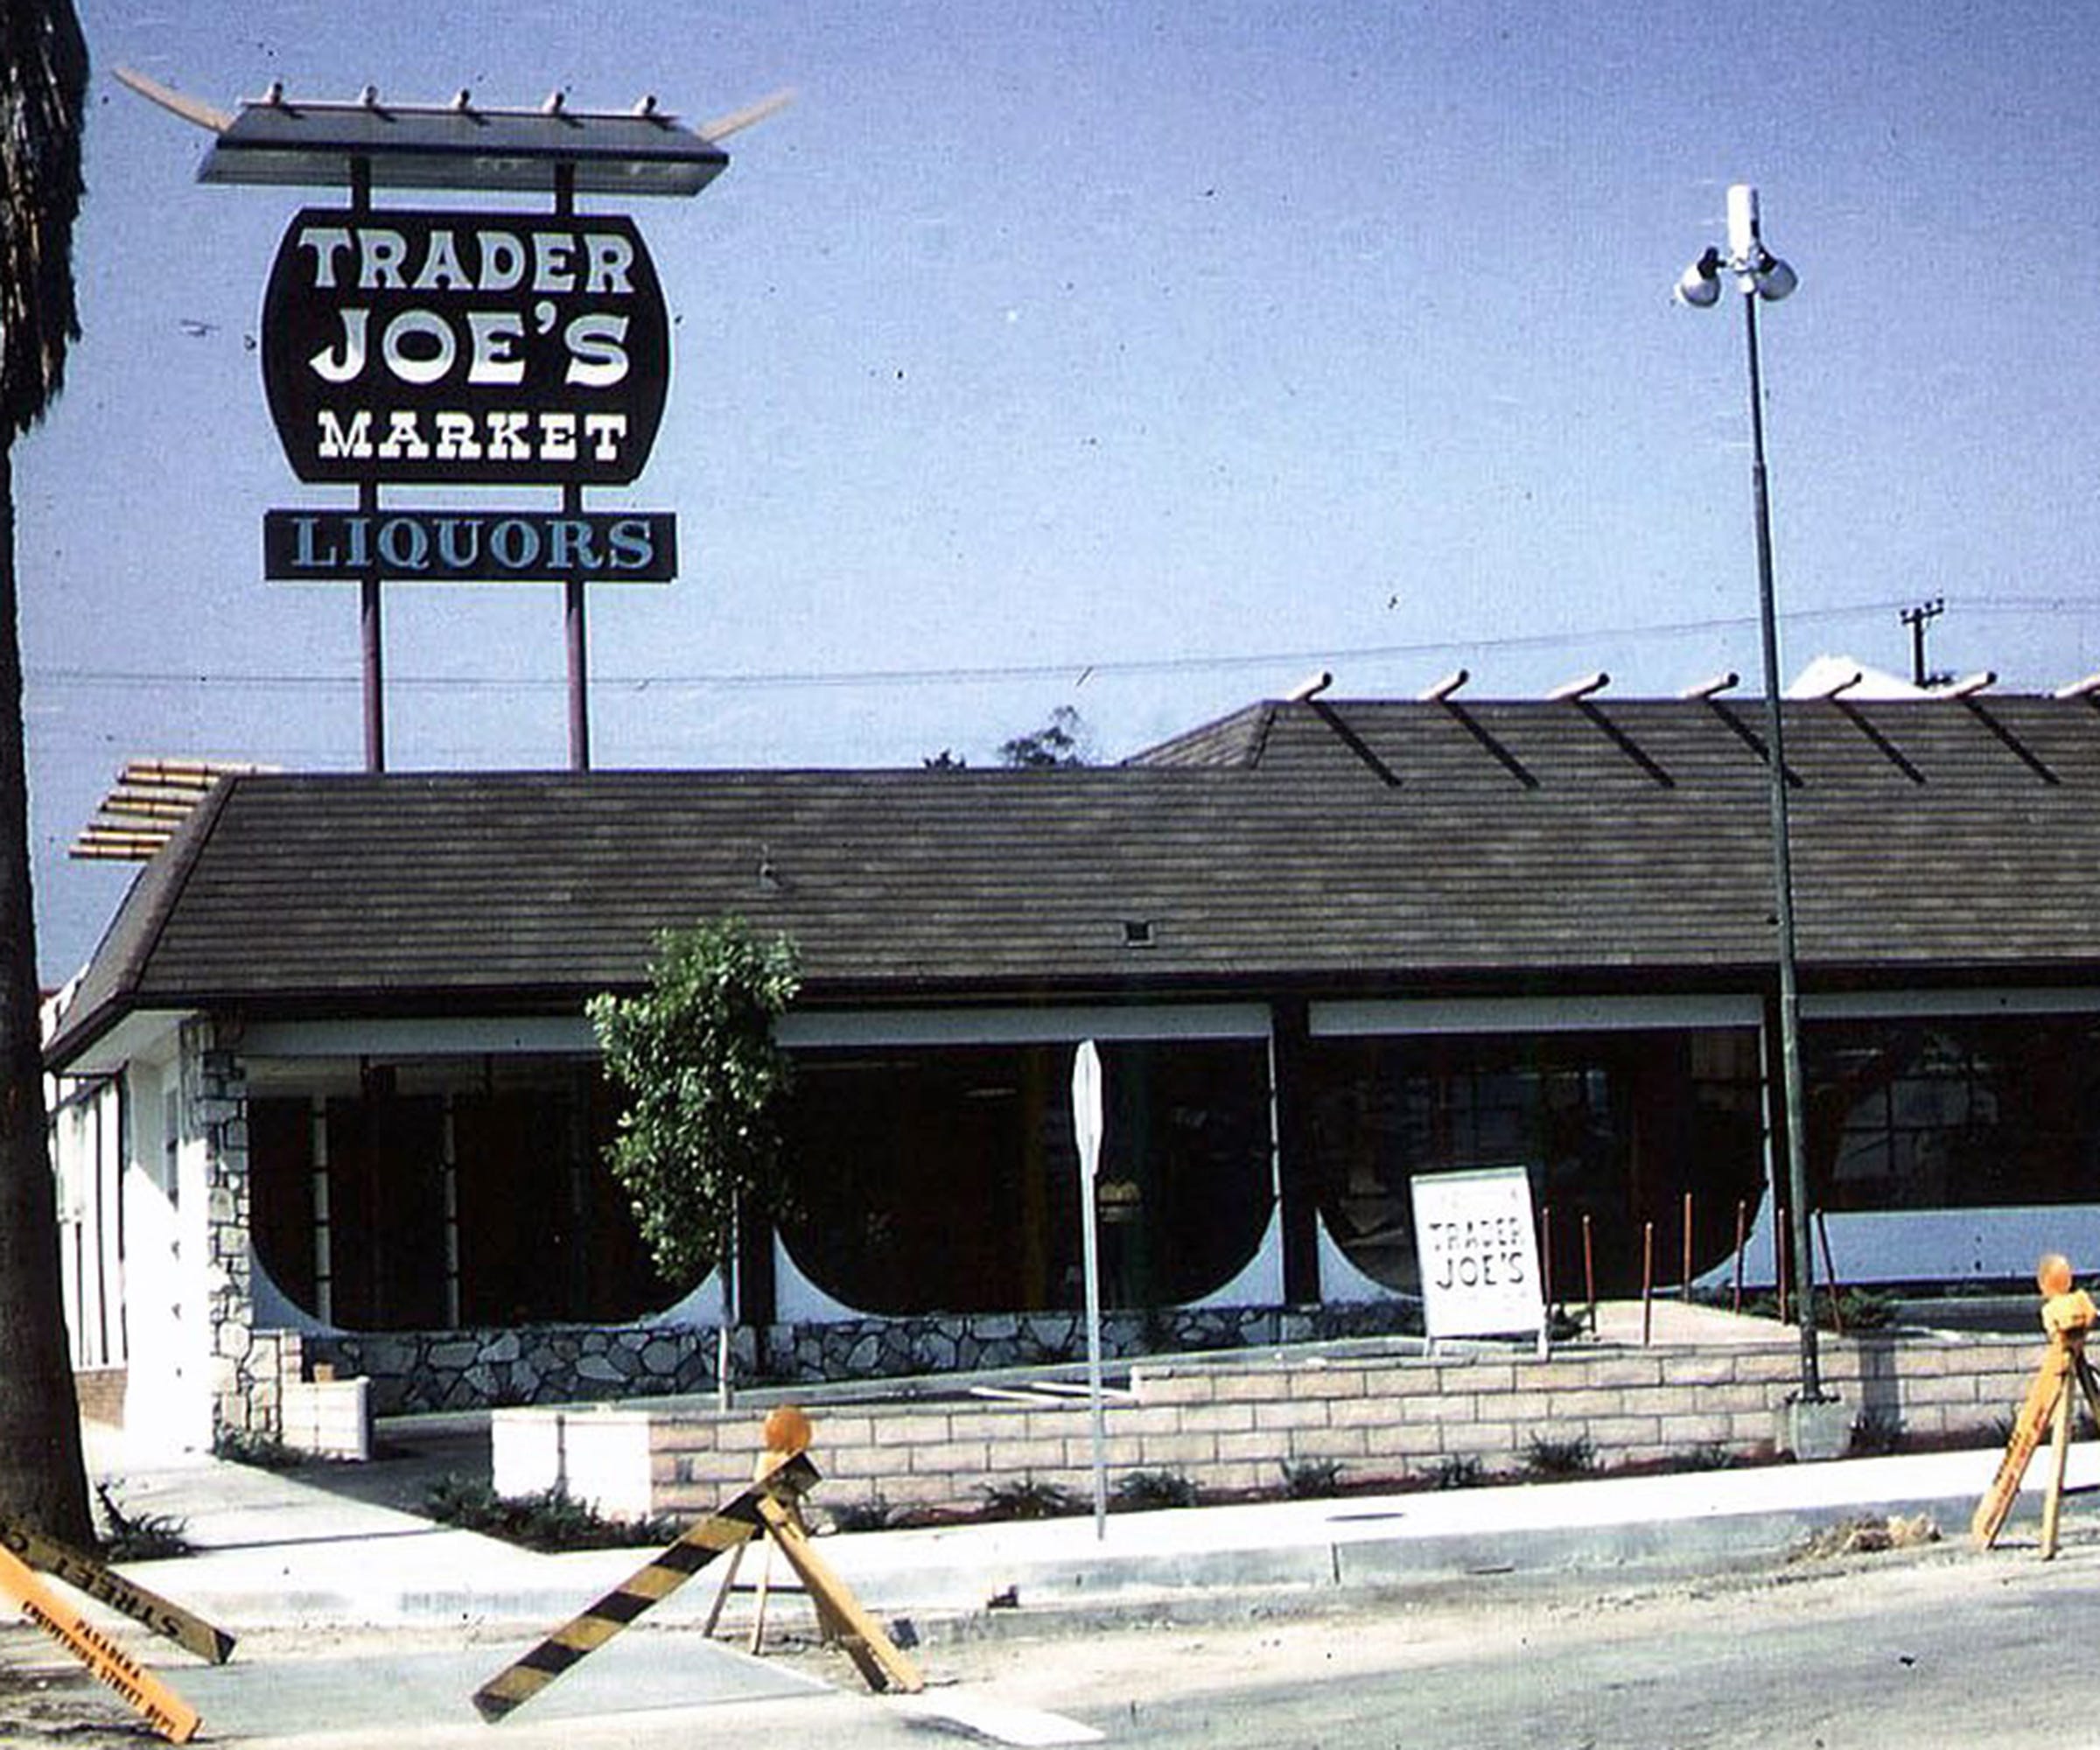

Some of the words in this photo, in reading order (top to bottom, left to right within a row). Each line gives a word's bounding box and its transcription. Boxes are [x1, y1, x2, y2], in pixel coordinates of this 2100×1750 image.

[297, 228, 635, 293] TRADER
[308, 300, 630, 388] JOE'S
[317, 410, 626, 461] MARKET
[290, 517, 654, 570] LIQUORS
[1427, 1215, 1525, 1251] TRADER
[1434, 1250, 1524, 1291] JOE'S
[52, 1556, 183, 1639] STREET
